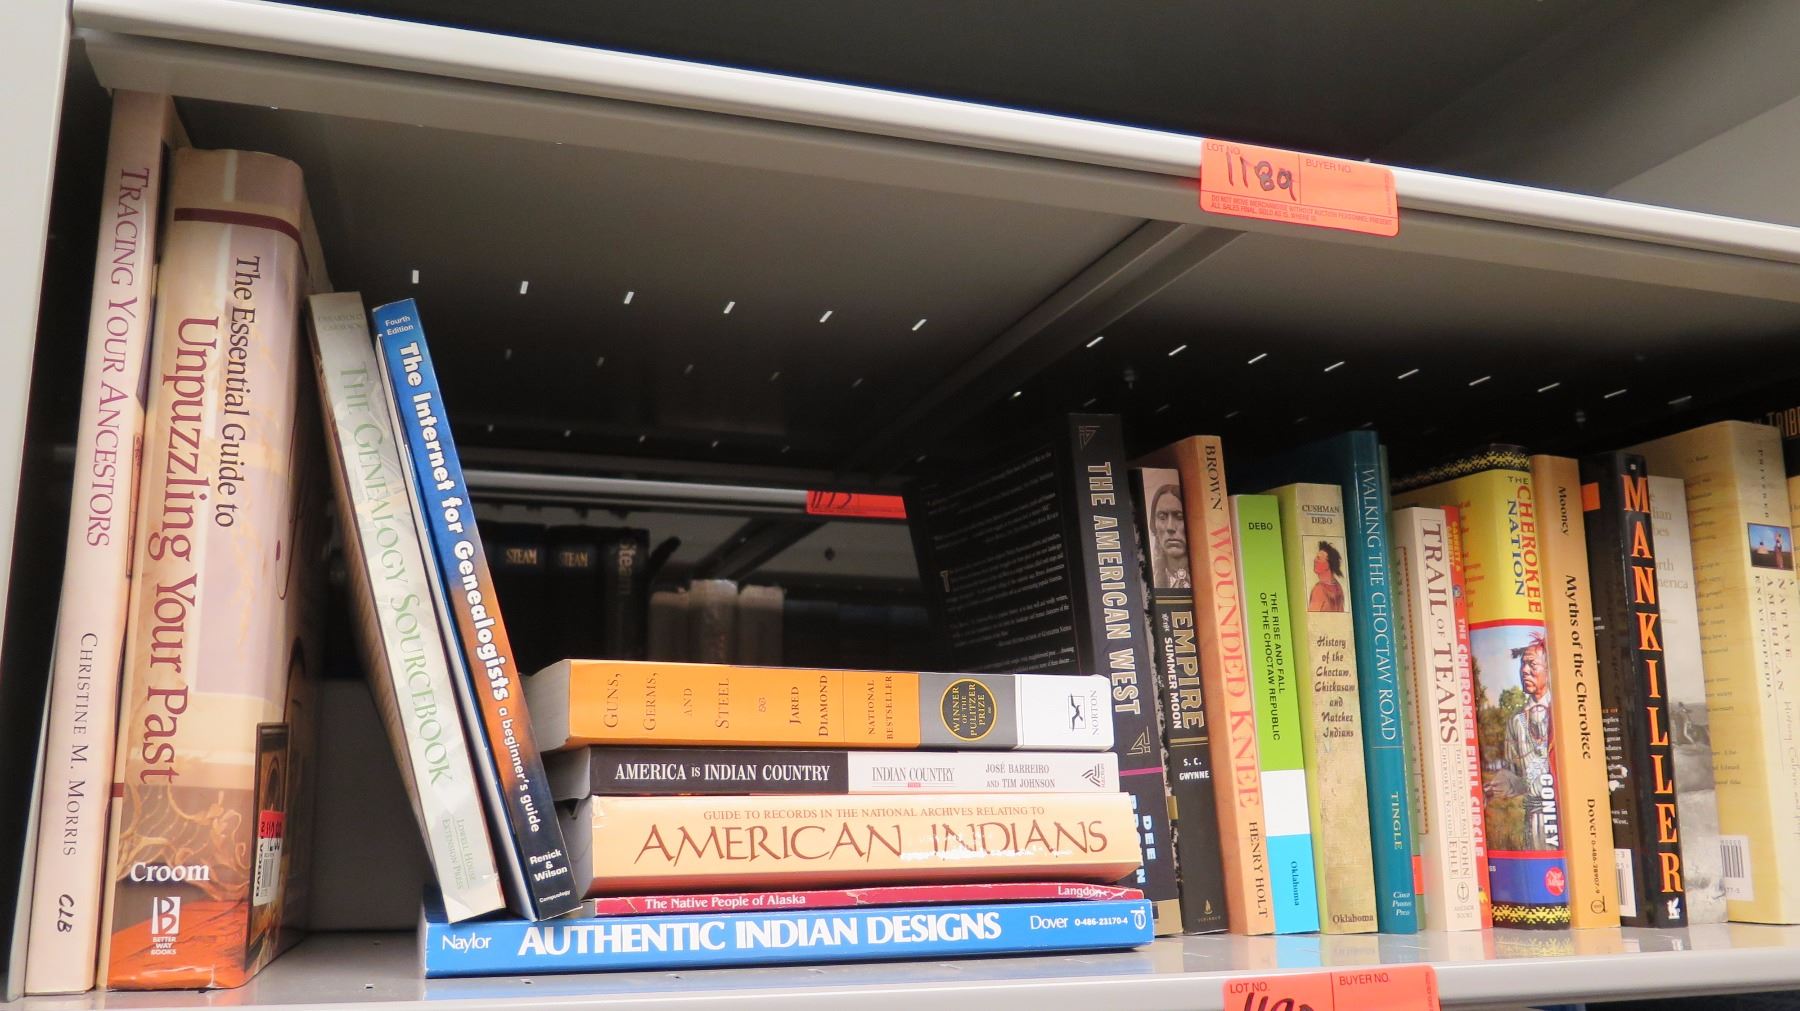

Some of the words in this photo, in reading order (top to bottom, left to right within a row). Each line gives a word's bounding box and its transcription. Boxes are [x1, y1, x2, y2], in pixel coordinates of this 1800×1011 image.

[1207, 143, 1223, 152] LOT
[1306, 159, 1336, 171] BUYER
[1226, 151, 1297, 202] 1189
[110, 167, 149, 286] TRACING
[232, 256, 260, 300] The
[102, 297, 138, 373] YOUR
[385, 315, 411, 326] Fourth
[387, 324, 414, 336] Edition
[223, 307, 255, 416] Essential
[400, 342, 422, 386] The
[148, 316, 219, 562] Unpuzzling
[413, 392, 455, 491] Internet
[87, 380, 129, 548] ANCESTORS
[219, 425, 246, 497] Guide
[1205, 445, 1222, 511] BROWN
[1508, 476, 1529, 484] THE
[1087, 461, 1116, 506] THE
[214, 504, 236, 528] to
[442, 496, 463, 534] for
[1248, 522, 1273, 530] DEBO
[1302, 505, 1339, 513] CUSHMAN
[1311, 517, 1333, 525] DEBO
[1362, 467, 1381, 548] WALKING
[1559, 486, 1569, 536] Mooney
[506, 549, 537, 564] STEAM
[560, 552, 588, 567] STEAM
[1507, 501, 1525, 596] NATION
[1517, 485, 1542, 613] CHEROKEE
[1093, 515, 1132, 640] AMERICAN
[1368, 552, 1384, 586] THE
[1423, 523, 1447, 615] TRAIL
[353, 423, 409, 583] GENEALOGY
[390, 593, 453, 786] SOURCEBOOK
[1260, 592, 1266, 605] OF
[1268, 592, 1276, 611] THE
[1566, 575, 1580, 626] Myths
[149, 573, 198, 673] Your
[454, 540, 509, 701] Genealogists
[1271, 615, 1280, 640] RISE
[1371, 592, 1392, 683] CHOCTAW
[1436, 618, 1446, 639] OF
[1264, 632, 1275, 685] CHOCTAW
[1274, 648, 1283, 666] AND
[1316, 637, 1346, 649] History
[1322, 653, 1329, 662] of
[1332, 653, 1343, 662] the
[1571, 631, 1583, 655] of
[1108, 648, 1141, 715] WEST
[1165, 637, 1177, 689] SUMMER
[1171, 611, 1204, 729] EMPIRE
[1210, 526, 1250, 698] WOUNDED
[1231, 709, 1260, 808] KNEE
[1278, 668, 1286, 693] FALL
[1574, 652, 1584, 678] the
[73, 632, 98, 734] CHRISTINE
[603, 673, 622, 728] GUNS,
[643, 672, 657, 731] GERMS,
[683, 687, 693, 716] AND
[1433, 642, 1459, 744] TEARS
[1621, 474, 1683, 893] MANKILLER
[498, 707, 507, 717] a
[716, 678, 729, 729] STEEL
[789, 686, 801, 725] JARED
[818, 675, 828, 737] DIAMOND
[952, 687, 961, 732] WINNER
[962, 713, 968, 724] OF
[968, 683, 978, 736] PULITZER
[978, 694, 986, 726] PRIZE
[1091, 690, 1099, 735] NORTON
[1170, 692, 1182, 729] MOON
[1269, 688, 1280, 740] REPUBLIC
[1321, 713, 1354, 722] Natchez
[1329, 698, 1343, 707] and
[1379, 689, 1396, 740] ROAD
[1576, 681, 1592, 760] Cherokee
[140, 685, 189, 785] Past
[1322, 728, 1354, 738] Indians
[70, 743, 88, 770] M.
[501, 718, 528, 791] beginner's
[614, 763, 687, 780] AMERICA
[691, 766, 701, 778] IS
[703, 764, 757, 780] INDIAN
[762, 764, 831, 781] COUNTRY
[985, 761, 1006, 774] JOSÉ
[1009, 764, 1050, 774] BARREIRO
[1193, 757, 1202, 765] C.
[871, 767, 907, 782] INDIAN
[909, 767, 955, 782] COUNTRY
[986, 780, 1000, 788] AND
[1001, 778, 1018, 788] TIM
[1019, 778, 1056, 788] JOHNSON
[1179, 770, 1210, 781] GWYNNE
[63, 780, 85, 857] MORRIS
[520, 795, 539, 832] guide
[704, 809, 741, 820] GUIDE
[744, 810, 760, 820] TO
[764, 809, 817, 819] RECORDS
[820, 809, 832, 819] IN
[836, 808, 858, 818] THE
[861, 807, 917, 817] NATIONAL
[920, 807, 973, 817] ARCHIVES
[976, 807, 1028, 816] RELATING
[1031, 806, 1045, 816] TO
[1391, 792, 1403, 850] TINGLE
[1540, 773, 1559, 846] CONLEY
[1587, 798, 1597, 838] Dover
[530, 848, 561, 865] Renick
[633, 822, 901, 867] AMERICAN
[931, 820, 1108, 861] INDIANS
[1143, 815, 1157, 860] DEE
[130, 861, 210, 884] Croom
[534, 865, 568, 881] Wilson
[546, 861, 553, 869] &
[1248, 821, 1262, 876] HENRY
[1255, 878, 1268, 918] HOLT
[1449, 840, 1458, 876] EHLE
[1461, 840, 1470, 876] JOHN
[645, 898, 668, 909] The
[670, 897, 709, 908] Native
[711, 896, 749, 909] People
[752, 894, 766, 906] of
[768, 894, 806, 905] Alaska
[1290, 861, 1300, 906] Oklahoma
[517, 921, 726, 956] AUTHENTIC
[736, 917, 859, 949] INDIAN
[867, 912, 1002, 944] DESIGNS
[1030, 914, 1069, 930] Dover
[1074, 916, 1129, 927] 0-486-23170-4
[1332, 914, 1374, 924] Oklahoma
[150, 948, 177, 956] BOOKS
[442, 933, 492, 954] Naylor
[1230, 983, 1249, 993] LOT
[1252, 982, 1270, 991] NO.
[1339, 974, 1372, 985] BUYER
[1374, 973, 1391, 983] NO.
